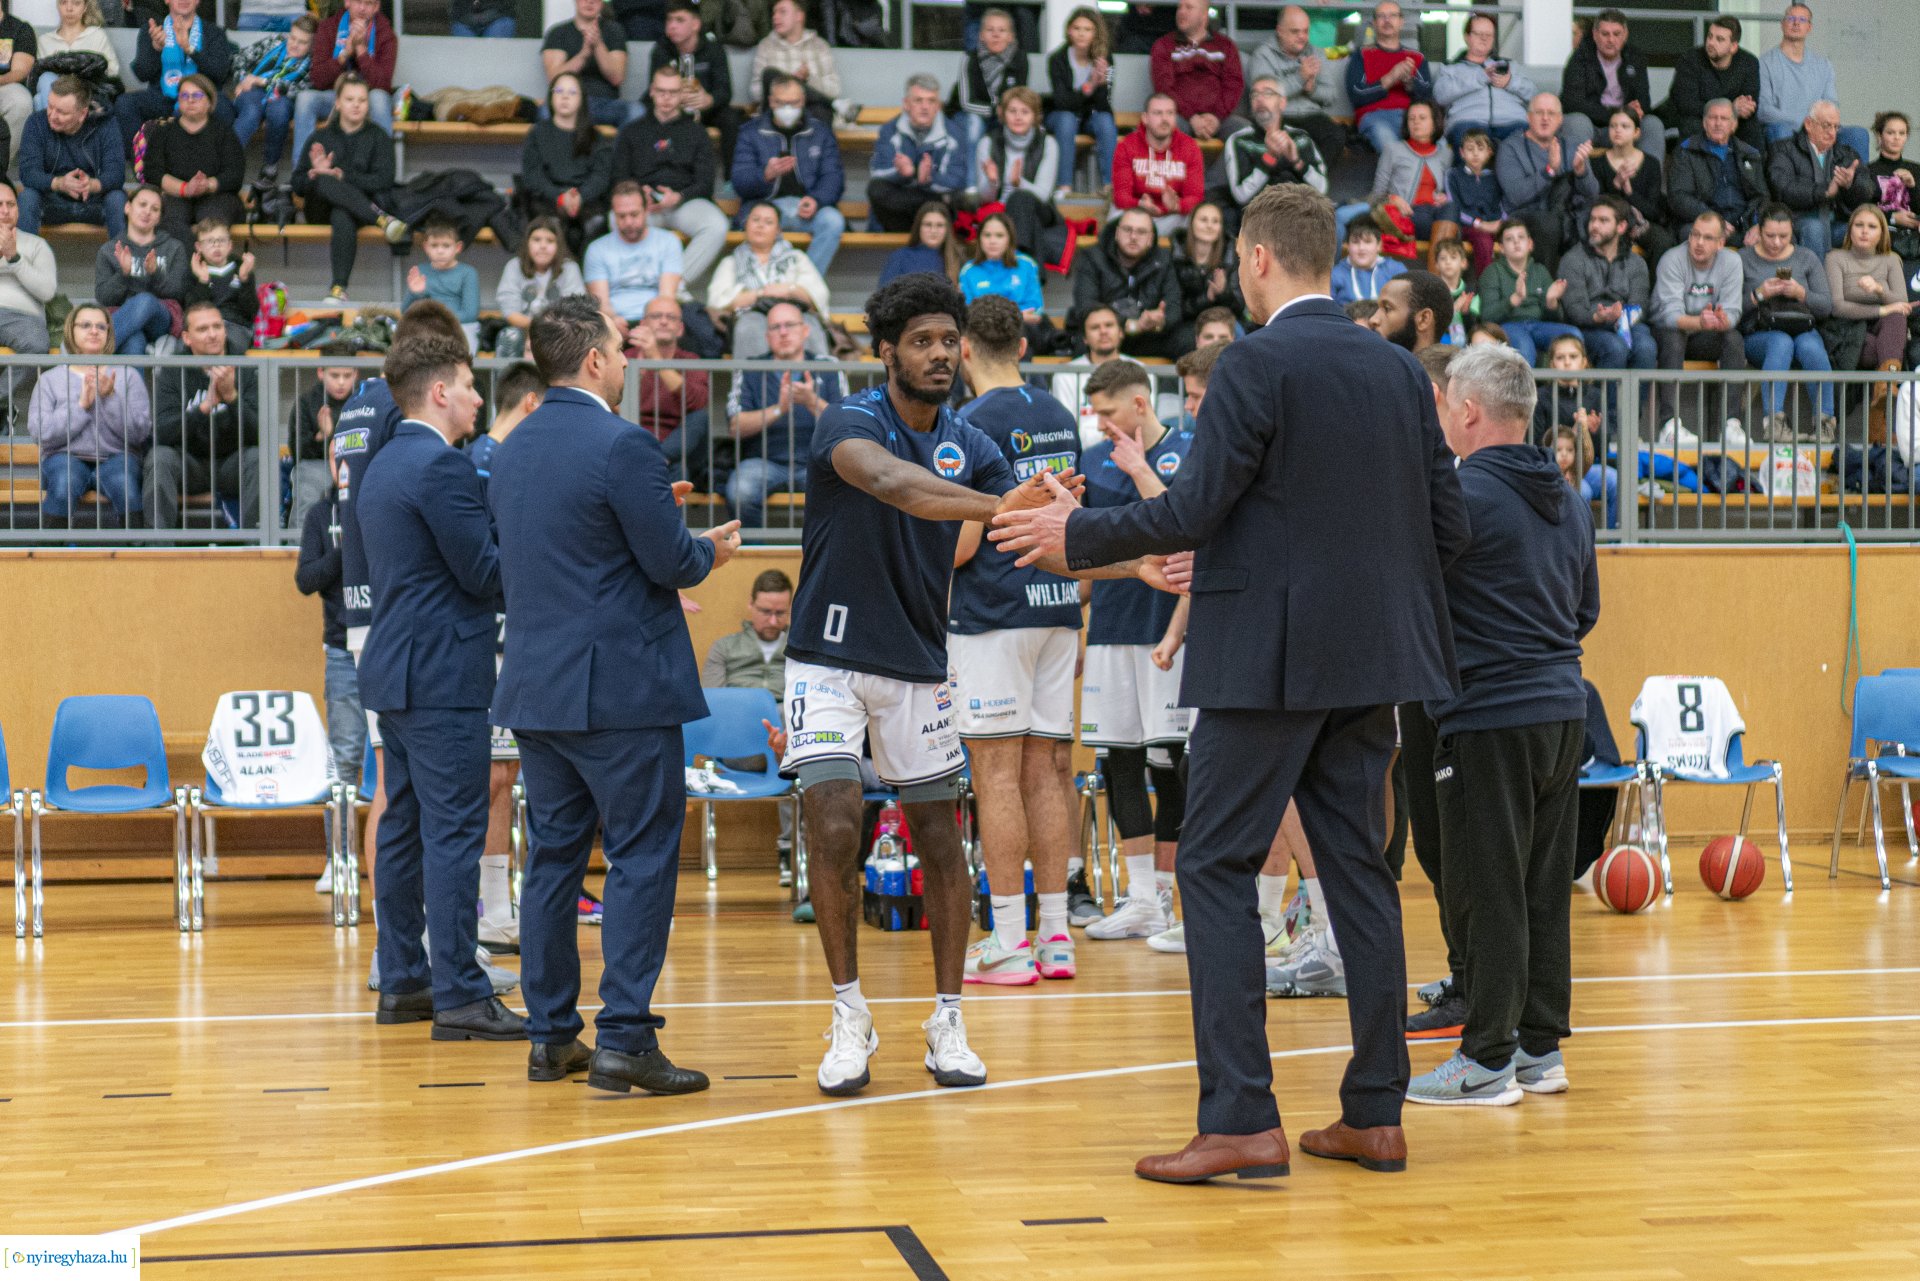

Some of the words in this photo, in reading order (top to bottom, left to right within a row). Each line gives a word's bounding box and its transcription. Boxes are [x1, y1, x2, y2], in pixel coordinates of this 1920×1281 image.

[823, 603, 849, 643] 0
[231, 691, 296, 748] 33
[1677, 683, 1705, 731] 8
[946, 747, 961, 762] JAK
